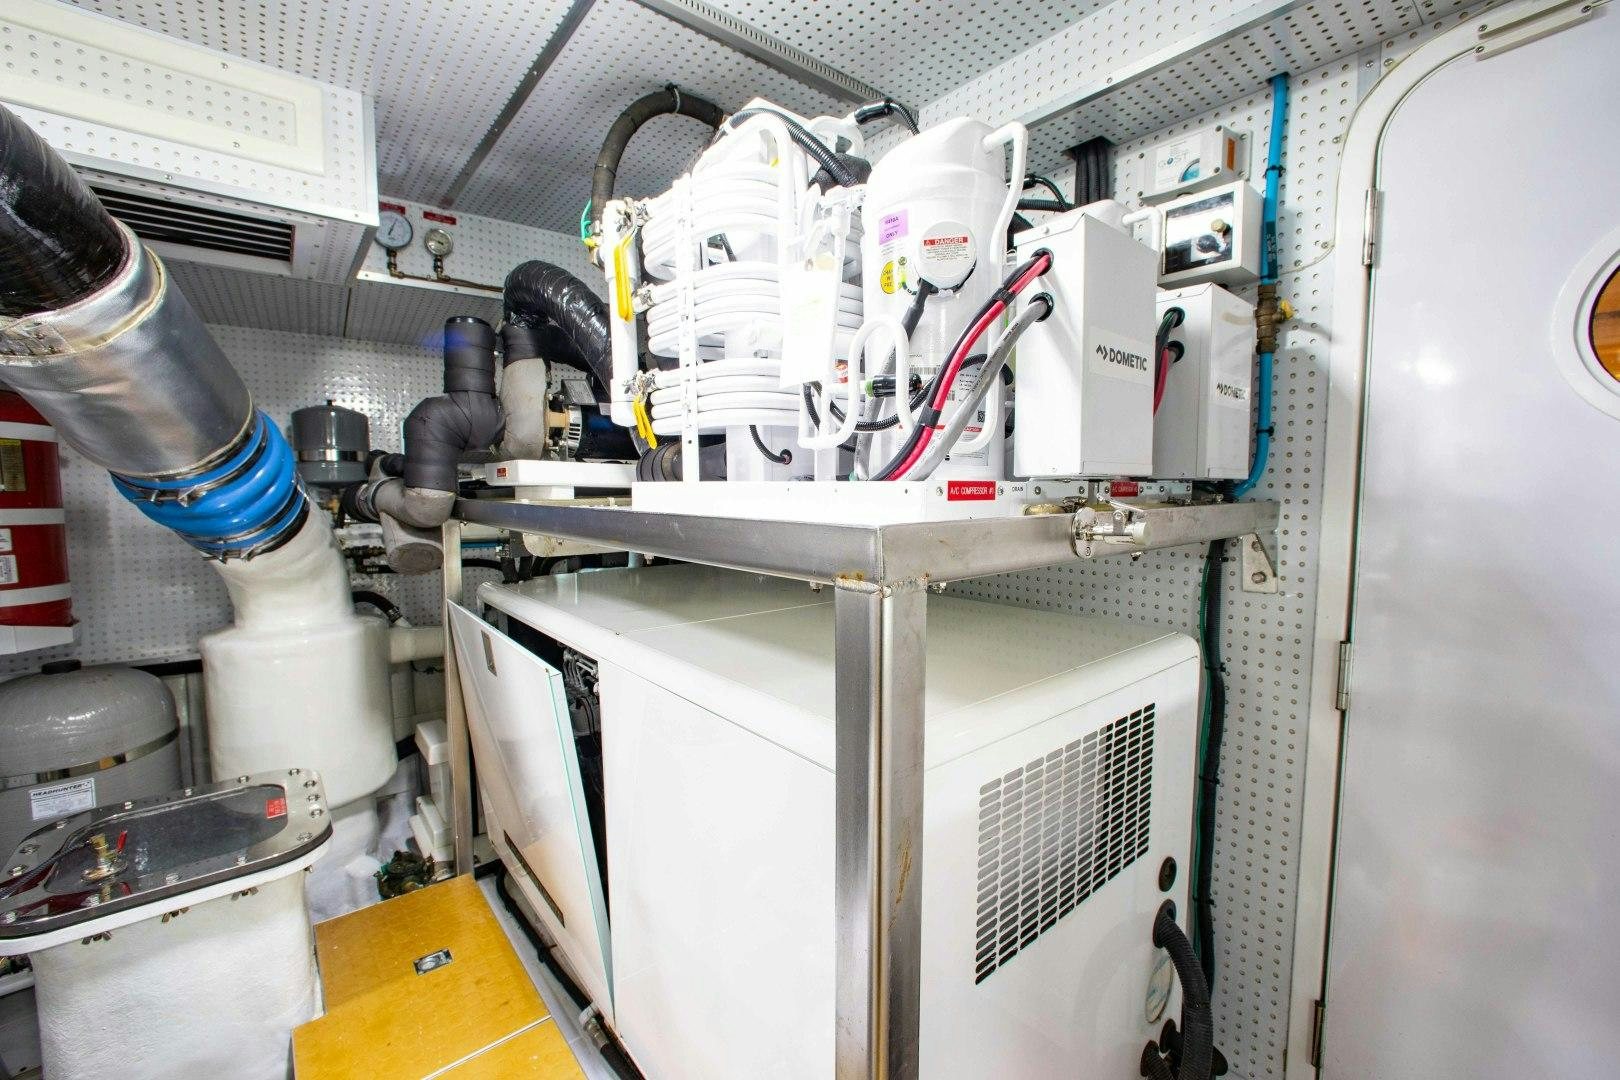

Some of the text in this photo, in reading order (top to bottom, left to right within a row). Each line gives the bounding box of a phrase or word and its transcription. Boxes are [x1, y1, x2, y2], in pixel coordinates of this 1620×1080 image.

[934, 237, 964, 245] DANGER
[1109, 347, 1147, 371] DOMETIC
[1223, 384, 1246, 400] DOMETIC
[950, 486, 959, 495] A/C
[960, 486, 988, 495] COMPRESSOR
[32, 783, 84, 797] HEADHUNTER
